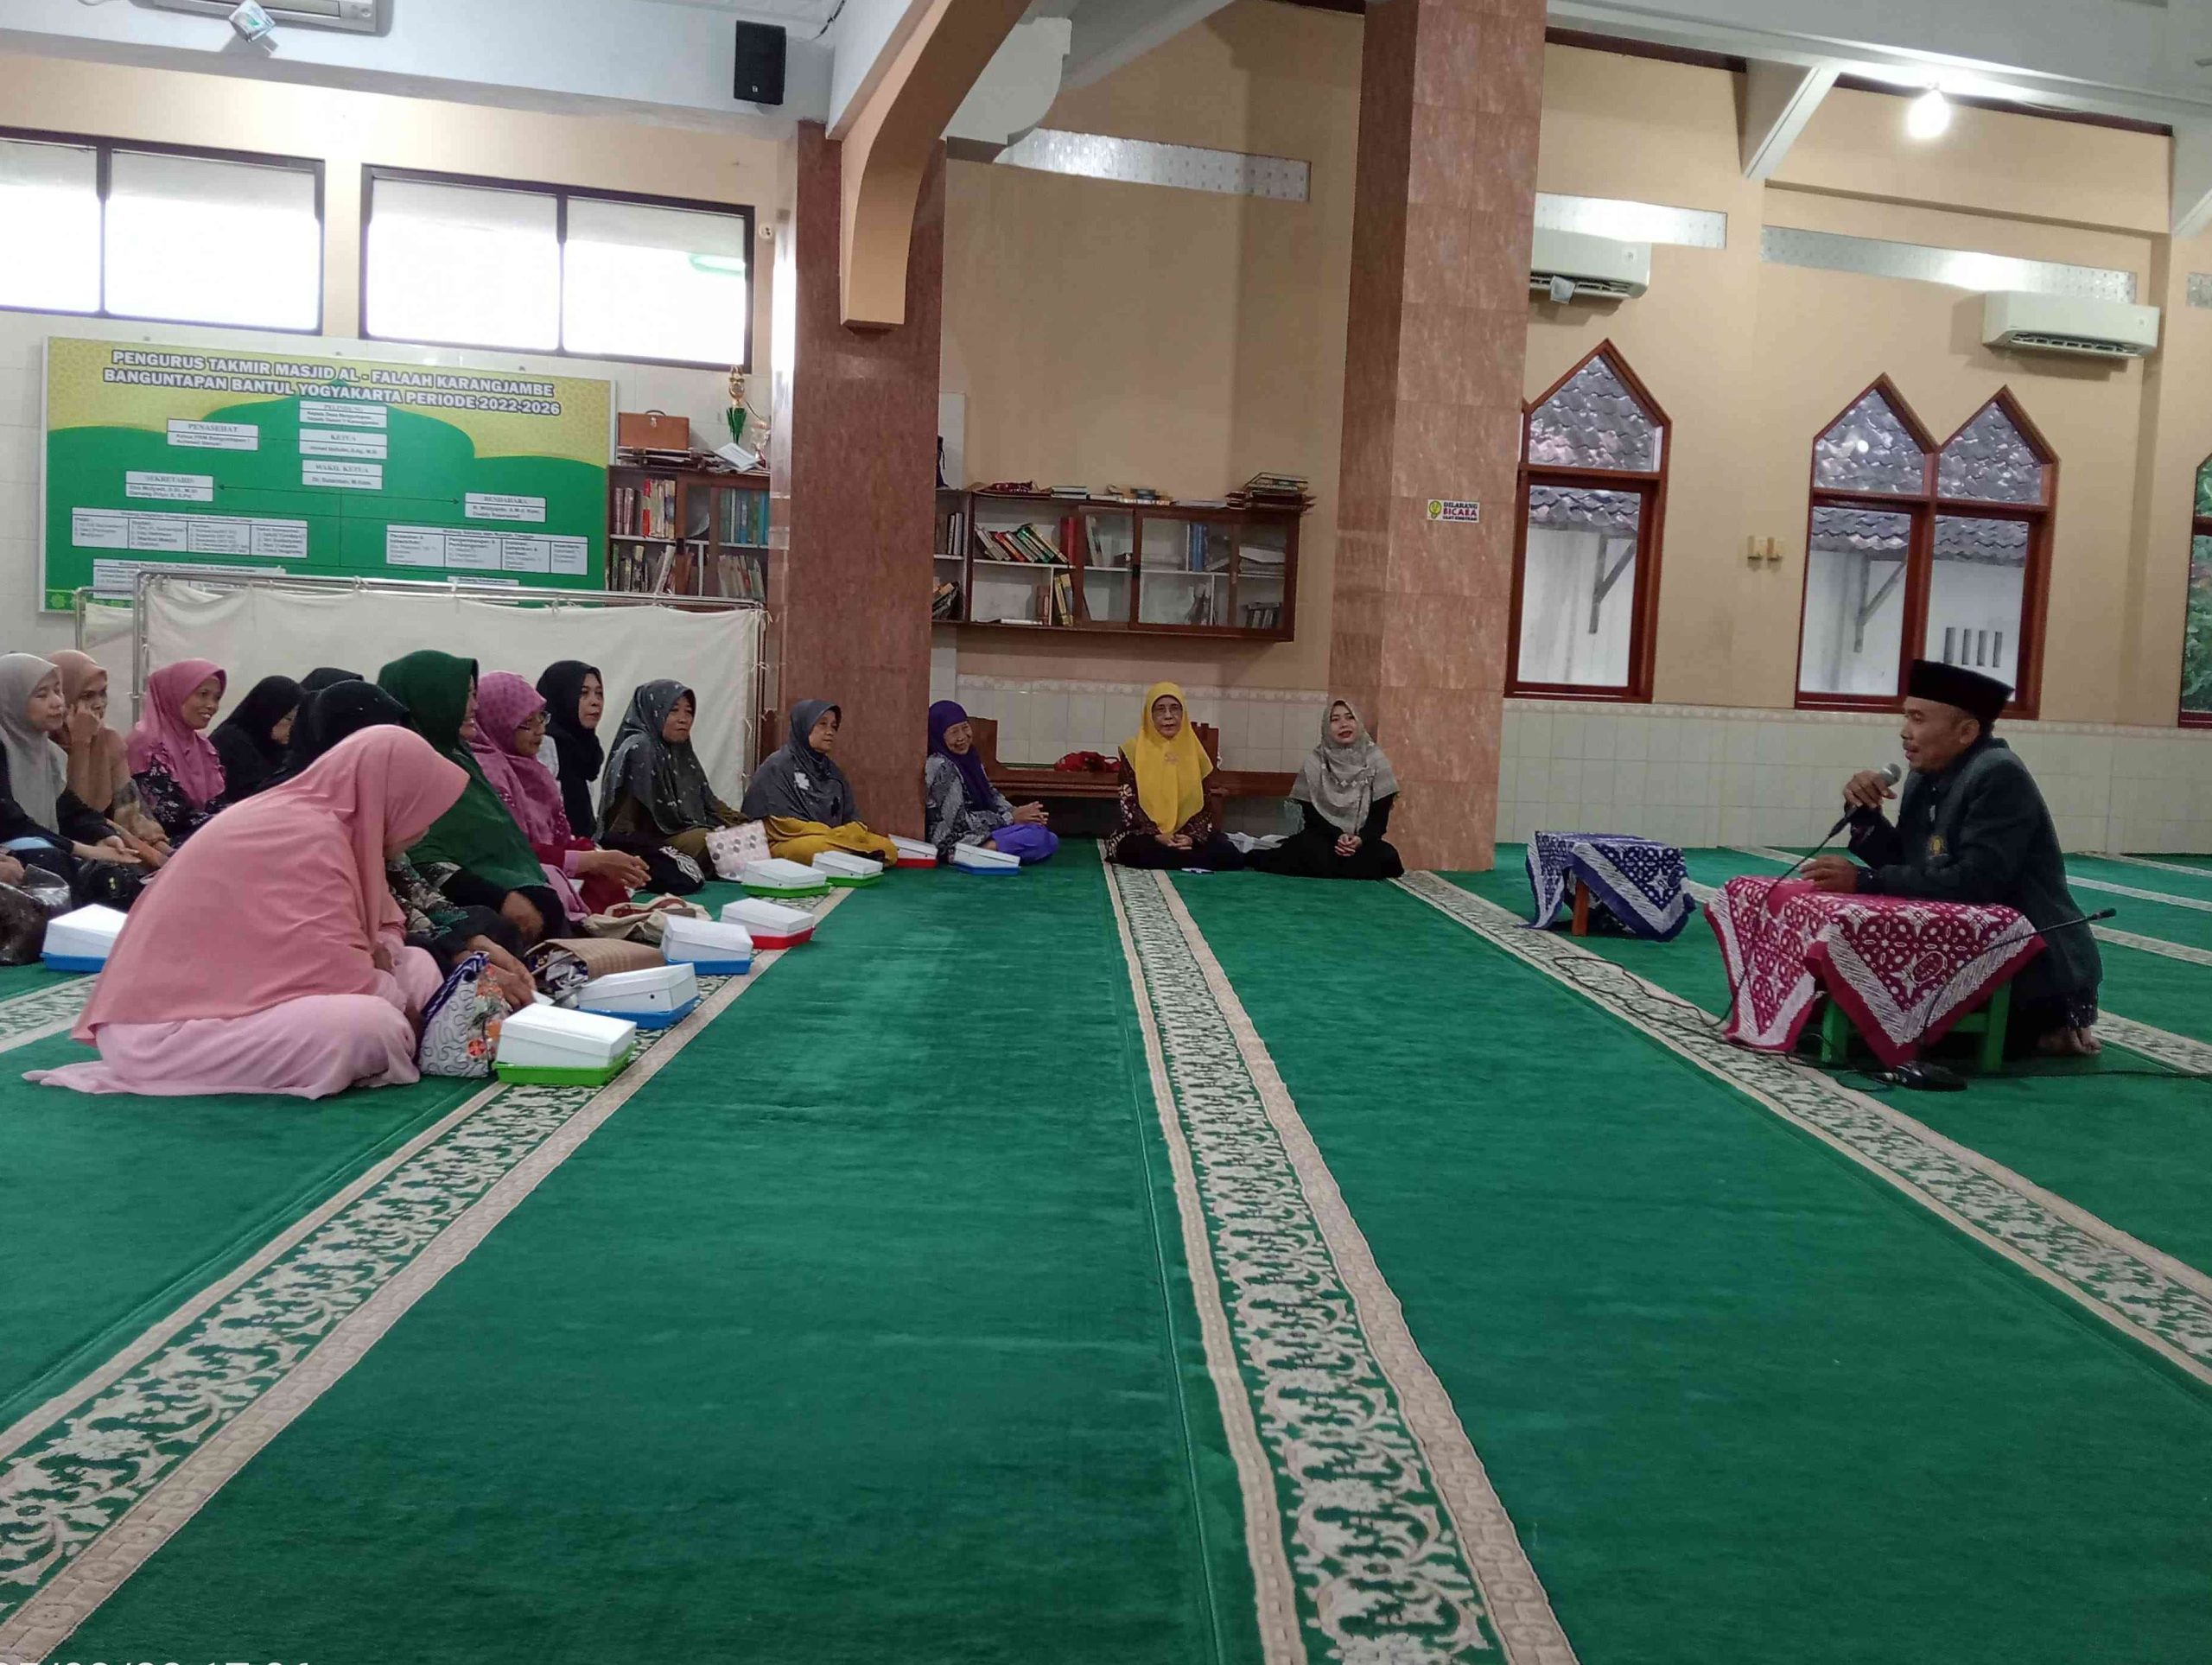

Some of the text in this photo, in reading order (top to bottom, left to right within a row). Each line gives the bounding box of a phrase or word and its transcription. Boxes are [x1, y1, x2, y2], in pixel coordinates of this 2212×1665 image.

[112, 350, 205, 370] PENGURUS
[208, 357, 272, 375] TAKMIR
[274, 362, 336, 380] MASJID
[338, 367, 359, 382] AL
[371, 370, 434, 387] FALAAH
[435, 373, 554, 397] KARANGJAMBE
[104, 368, 561, 416] BANGUNTAPAN BANTUL YOGYAKARTA PERIODE 2022-2026
[188, 423, 238, 432] PENASEHAT
[1443, 507, 1477, 517] BICARA
